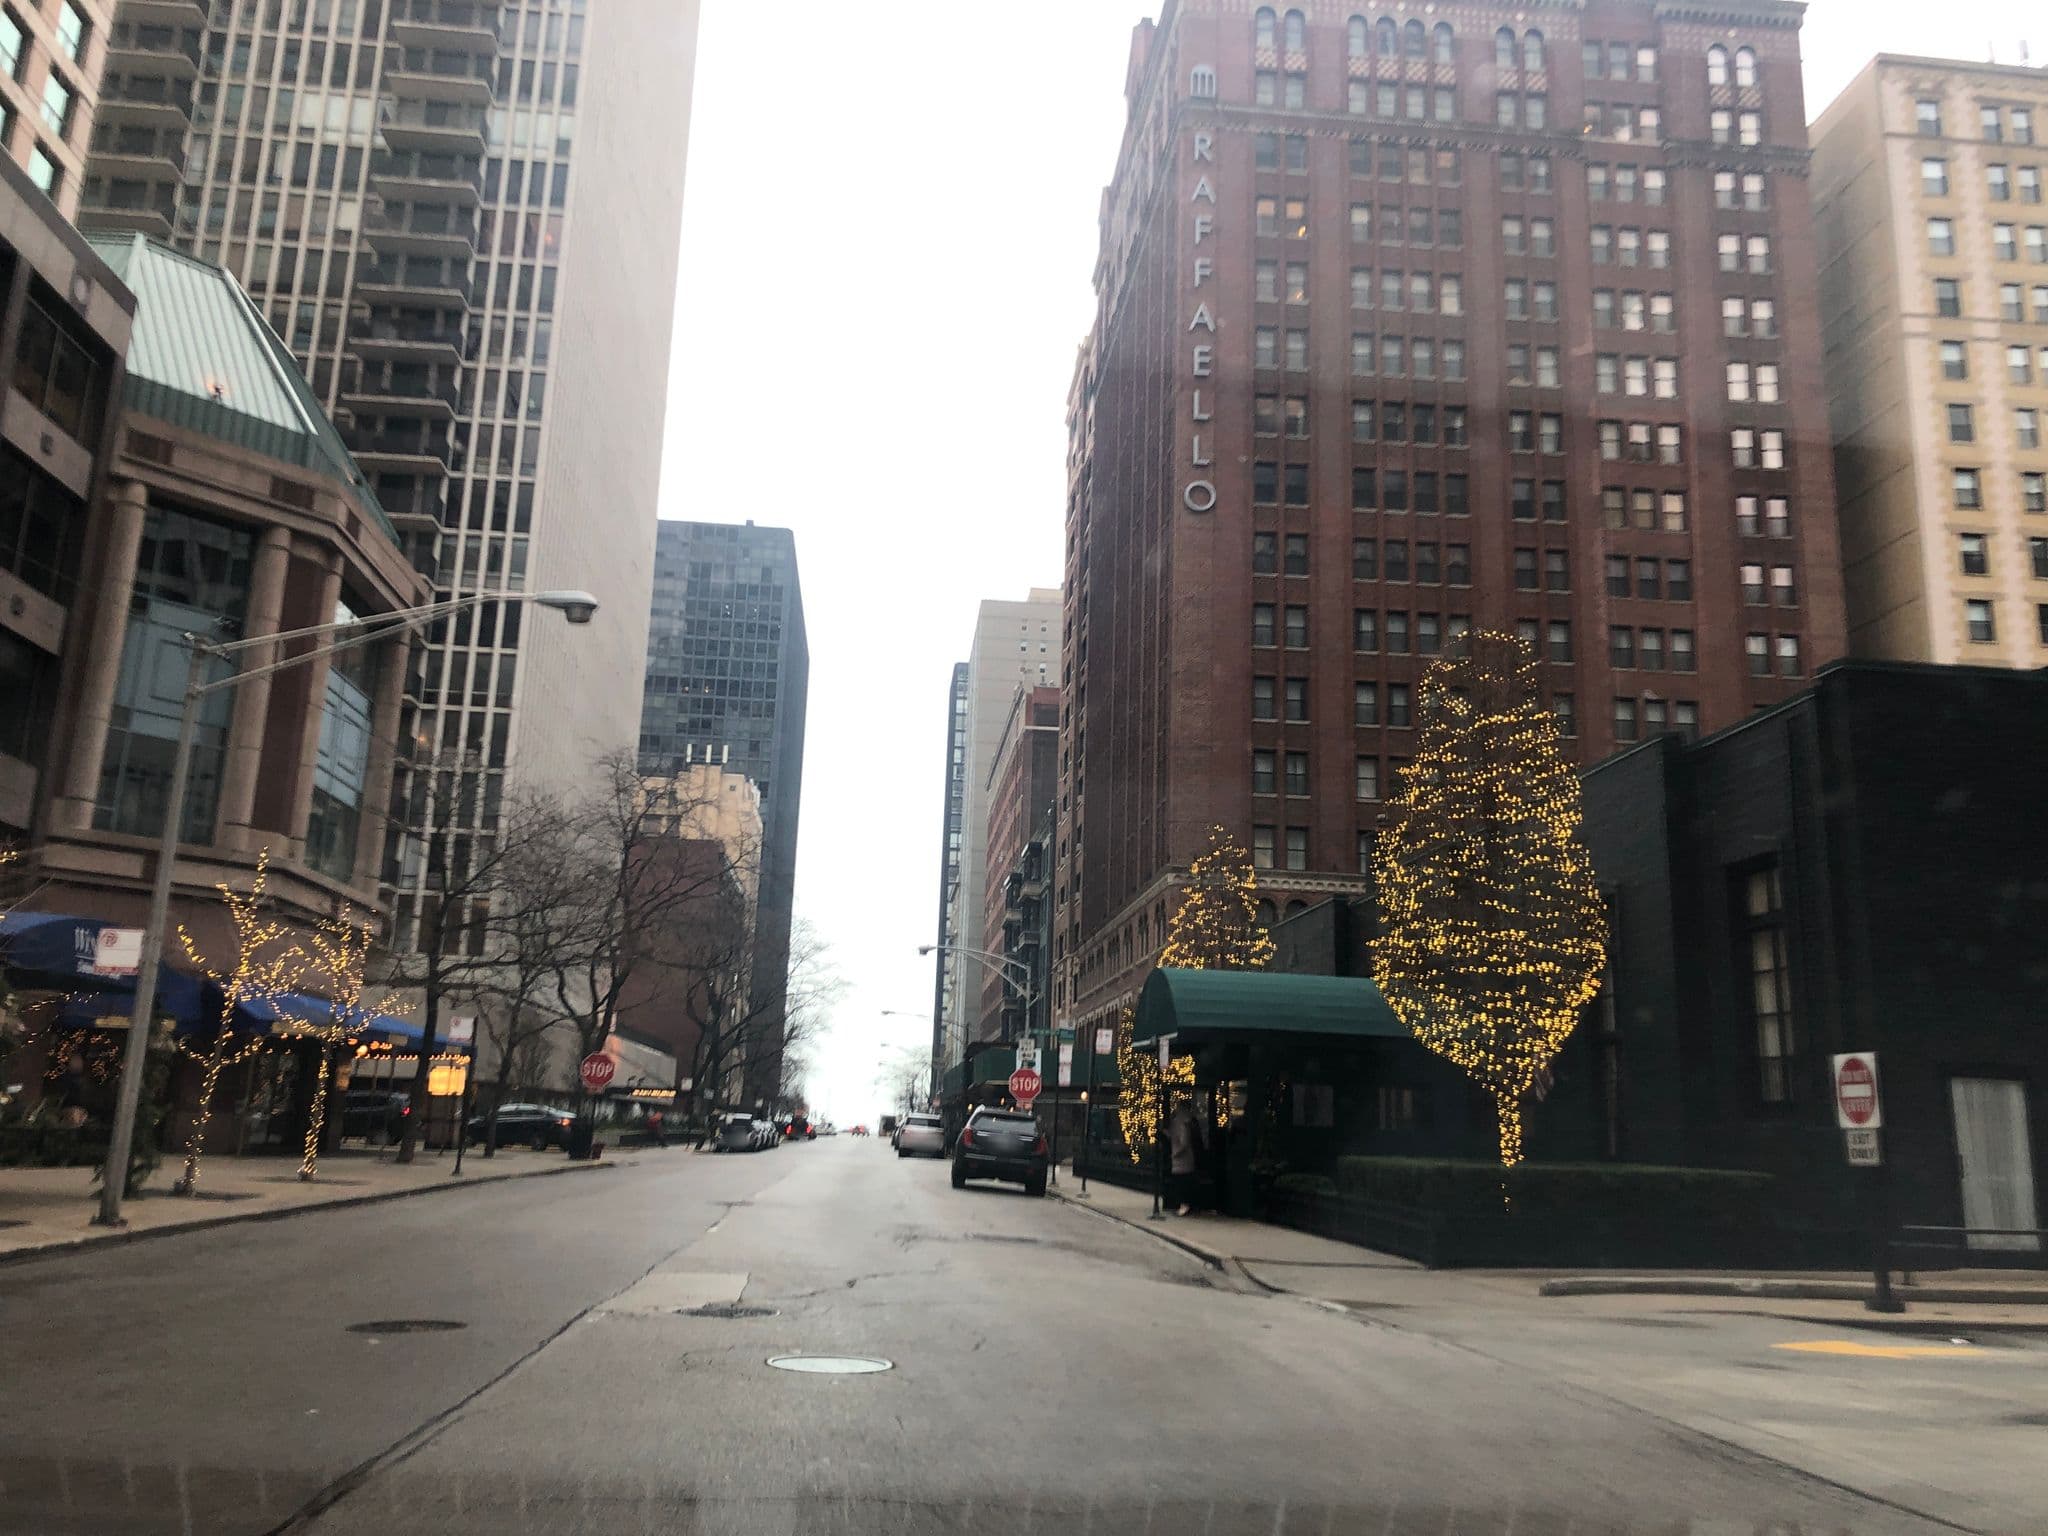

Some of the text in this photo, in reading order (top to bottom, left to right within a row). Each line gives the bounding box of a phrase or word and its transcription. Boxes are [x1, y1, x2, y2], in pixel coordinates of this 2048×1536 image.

[1183, 131, 1217, 512] RAFFAELLO
[583, 1062, 614, 1078] STOP
[1012, 1077, 1039, 1092] STOP
